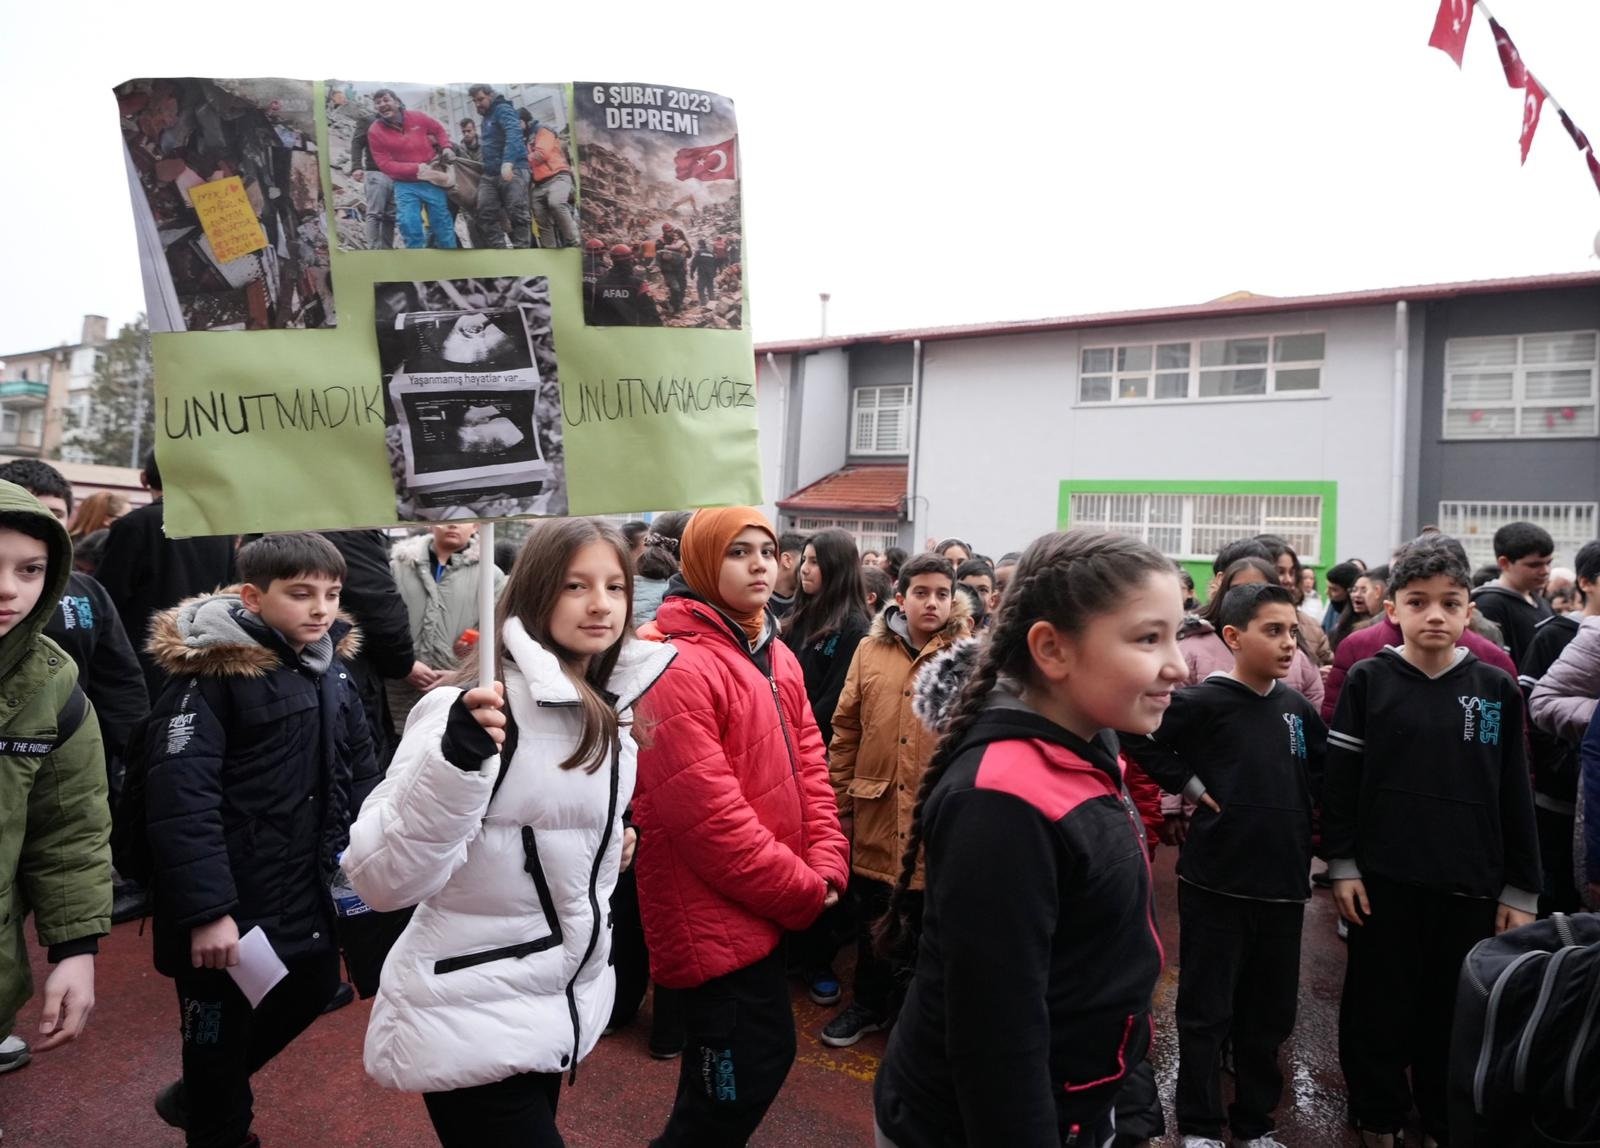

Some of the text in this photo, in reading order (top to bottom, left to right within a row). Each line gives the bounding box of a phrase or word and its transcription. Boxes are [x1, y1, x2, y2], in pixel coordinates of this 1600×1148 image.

[592, 86, 711, 113] 6 ŞUBAT 2023
[603, 288, 629, 298] AFAD
[408, 374, 463, 387] Yaşanmamış
[464, 373, 501, 386] hayatlar
[164, 375, 755, 440] UNUTMADIK UNUTMAYACAĞIZ
[73, 596, 94, 630] 1955
[1281, 712, 1298, 756] Şehitlik
[1457, 695, 1481, 741] Şehitlik
[1480, 698, 1502, 746] 1955
[12, 742, 28, 753] THE
